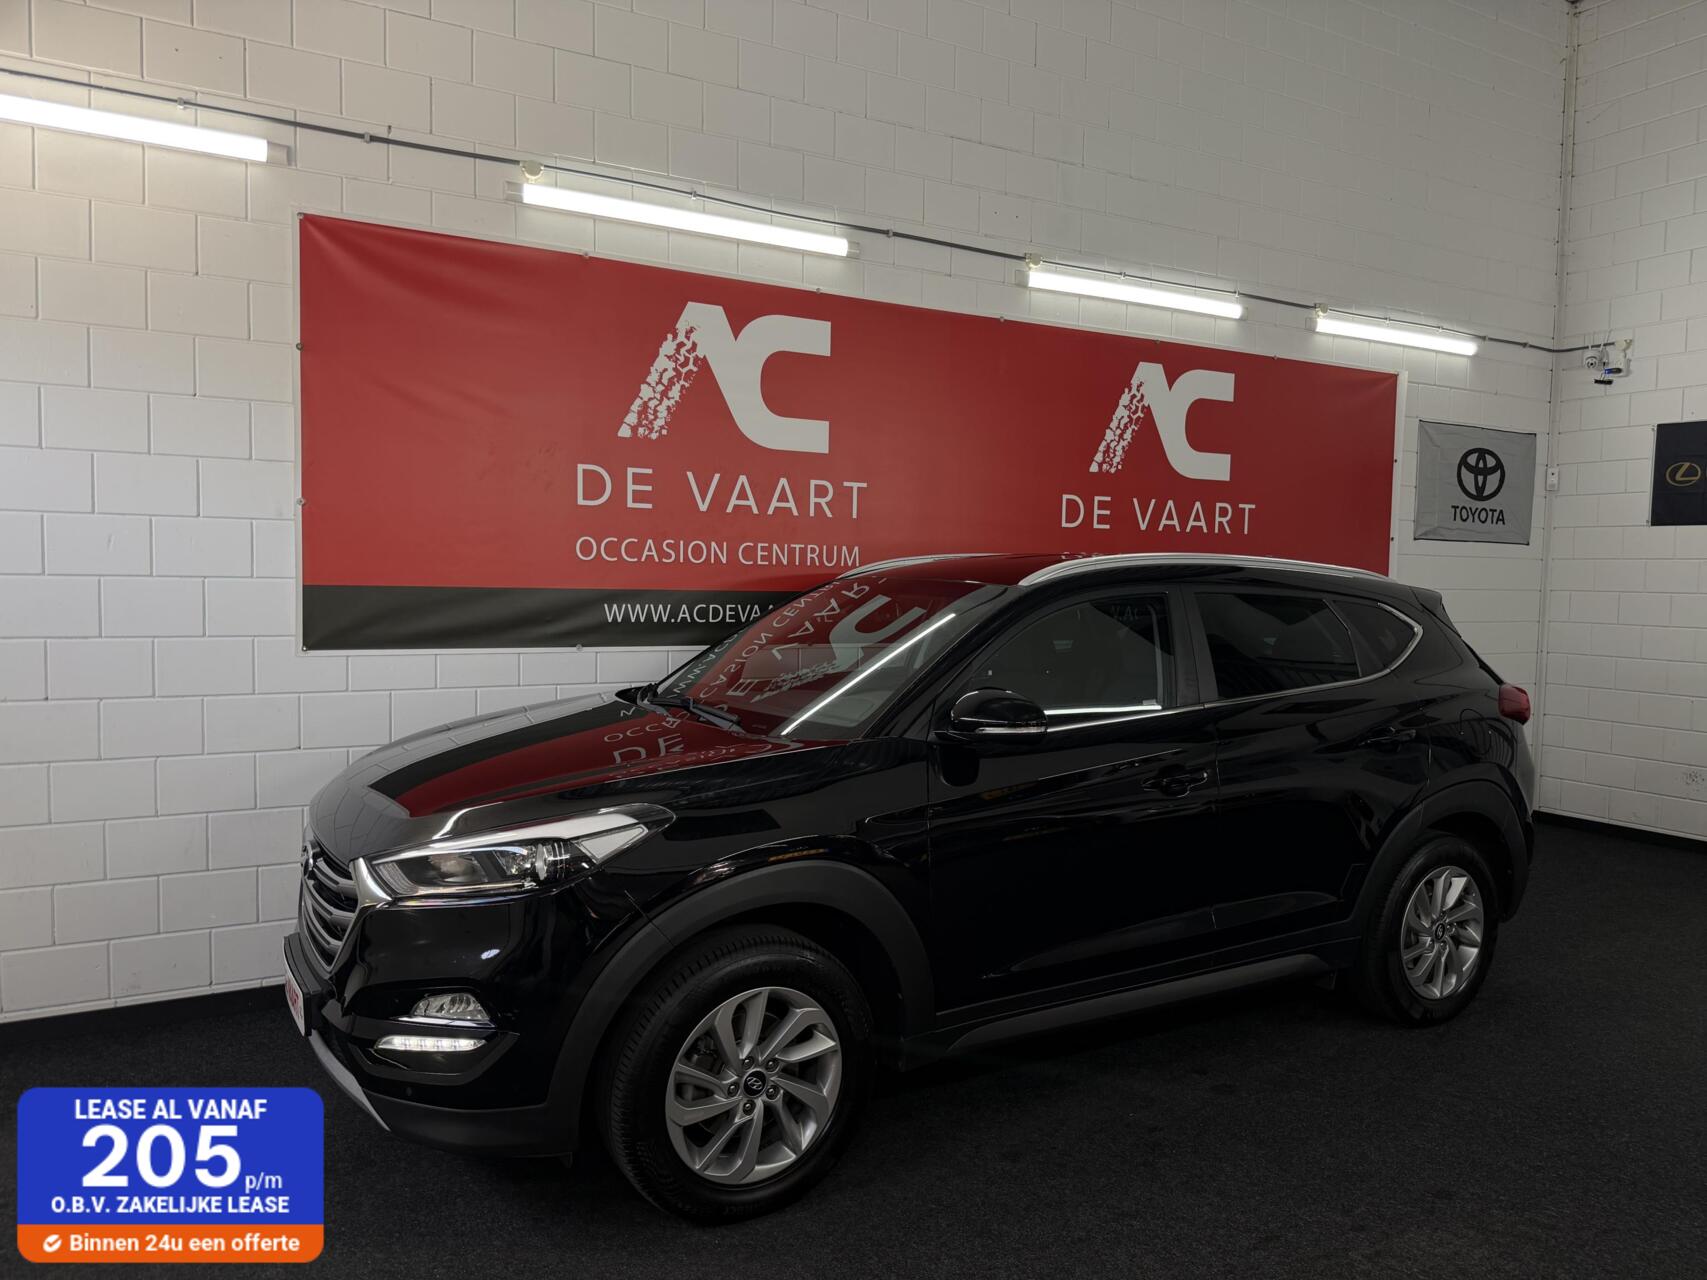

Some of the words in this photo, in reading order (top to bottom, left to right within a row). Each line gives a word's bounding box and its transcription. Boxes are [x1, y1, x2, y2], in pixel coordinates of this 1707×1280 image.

[617, 301, 832, 454] AC
[1089, 361, 1235, 481] AC
[576, 463, 654, 509] DE
[686, 471, 868, 519] VAART
[1061, 494, 1112, 530] DE
[1132, 497, 1256, 535] VAART
[1451, 505, 1506, 525] TOYOTA
[575, 536, 728, 565] OCCASION
[738, 542, 861, 568] CENTRUM
[603, 603, 774, 623] WWW.ACDEVA
